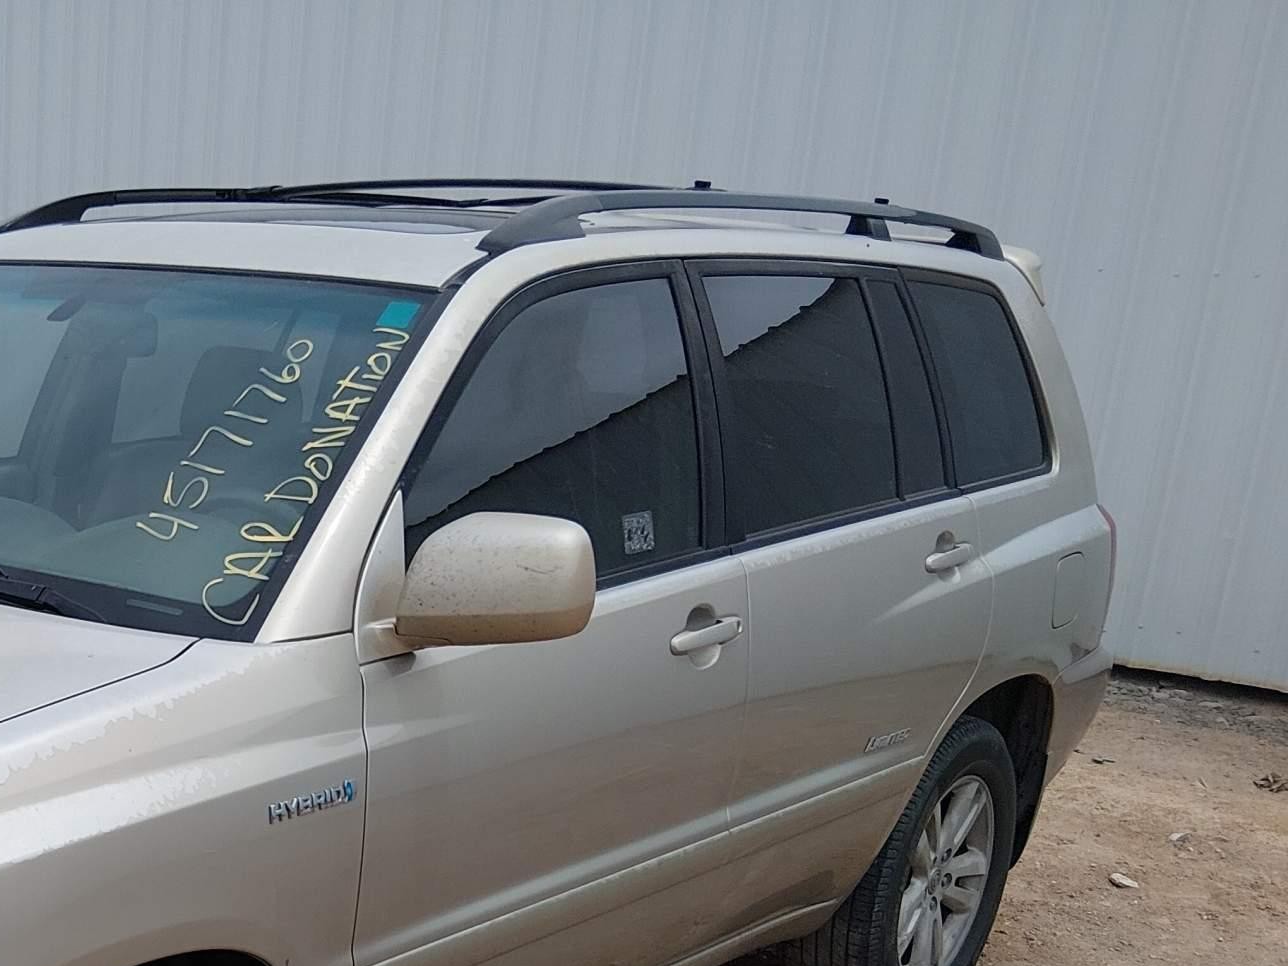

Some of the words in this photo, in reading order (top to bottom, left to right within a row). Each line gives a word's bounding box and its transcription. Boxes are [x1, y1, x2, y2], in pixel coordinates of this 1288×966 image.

[135, 338, 314, 541] 45171760
[201, 515, 305, 625] CAR
[263, 326, 410, 504] DONATION
[268, 785, 347, 825] HYBRID
